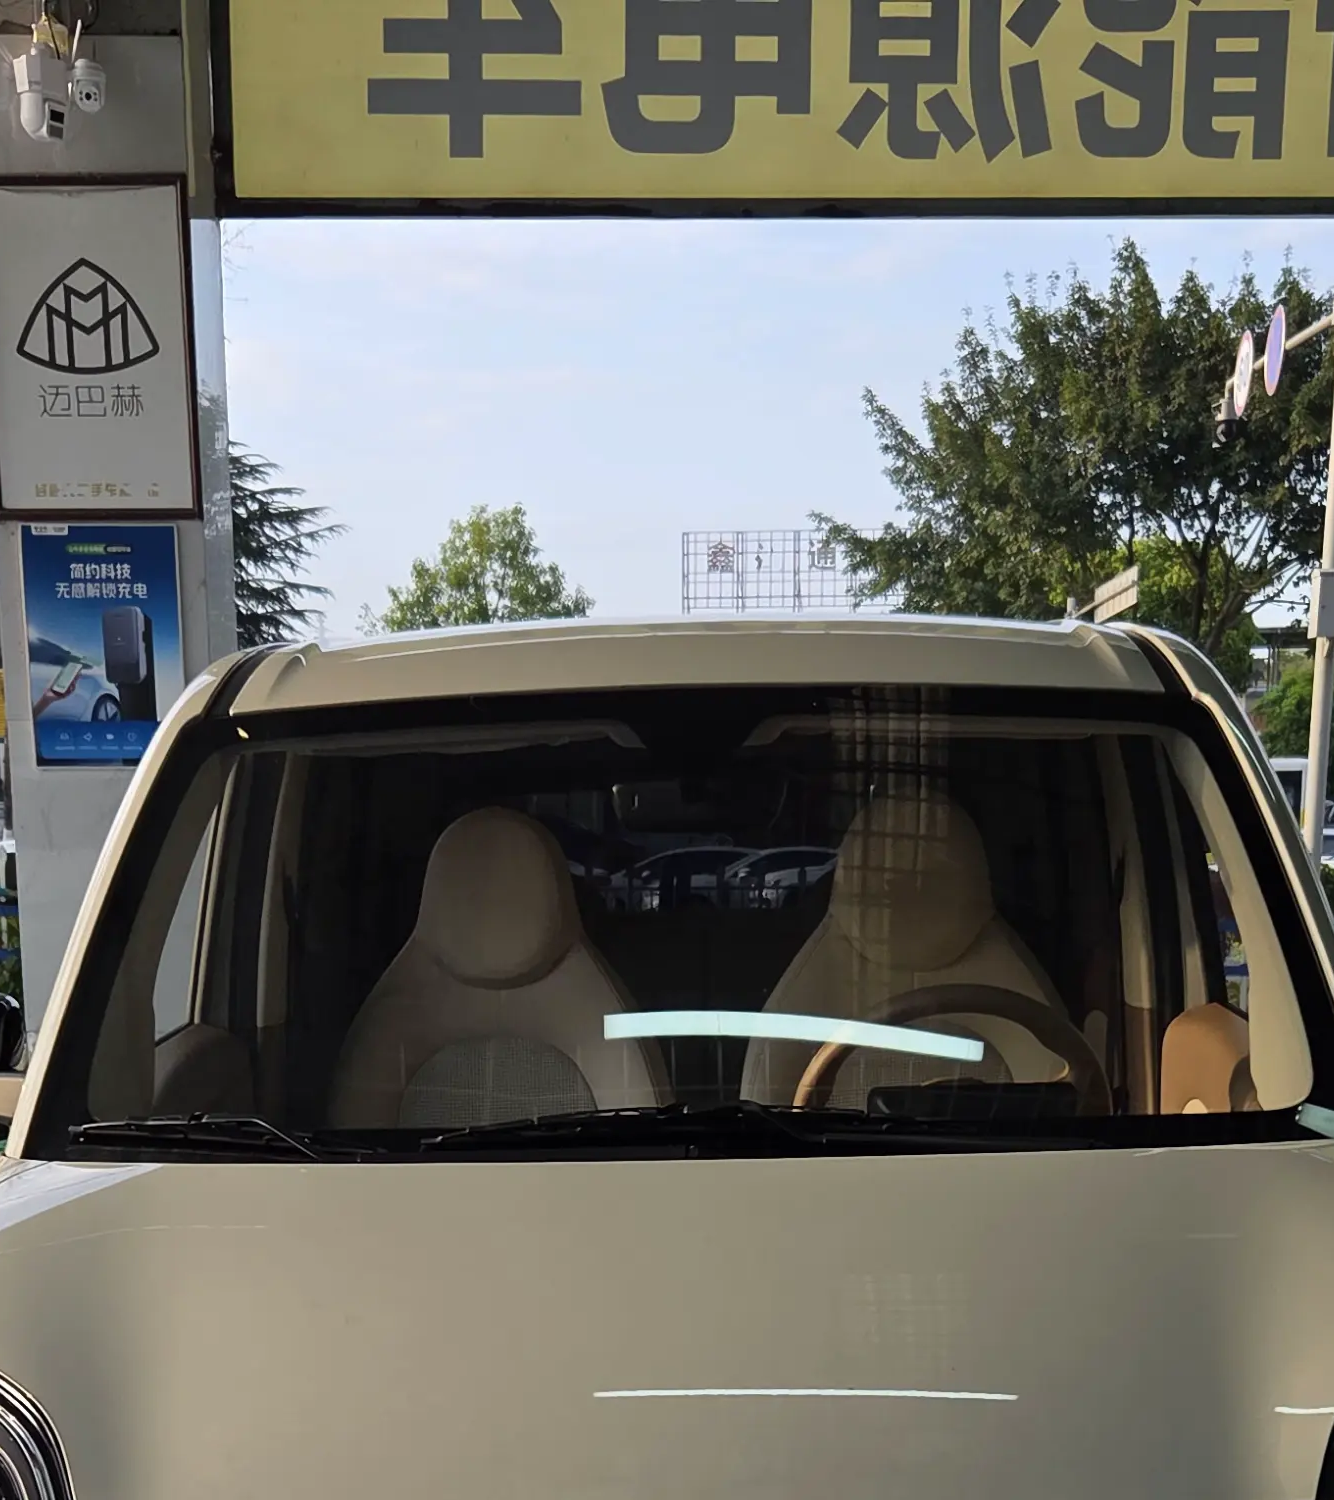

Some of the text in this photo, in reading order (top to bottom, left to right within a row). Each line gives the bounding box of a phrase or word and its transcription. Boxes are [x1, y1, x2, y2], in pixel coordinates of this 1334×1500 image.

[38, 383, 144, 418] 迈巴赫
[706, 535, 837, 574] 鑫通
[69, 563, 132, 580] 简约科技
[54, 582, 149, 600] 无感解锁充电
